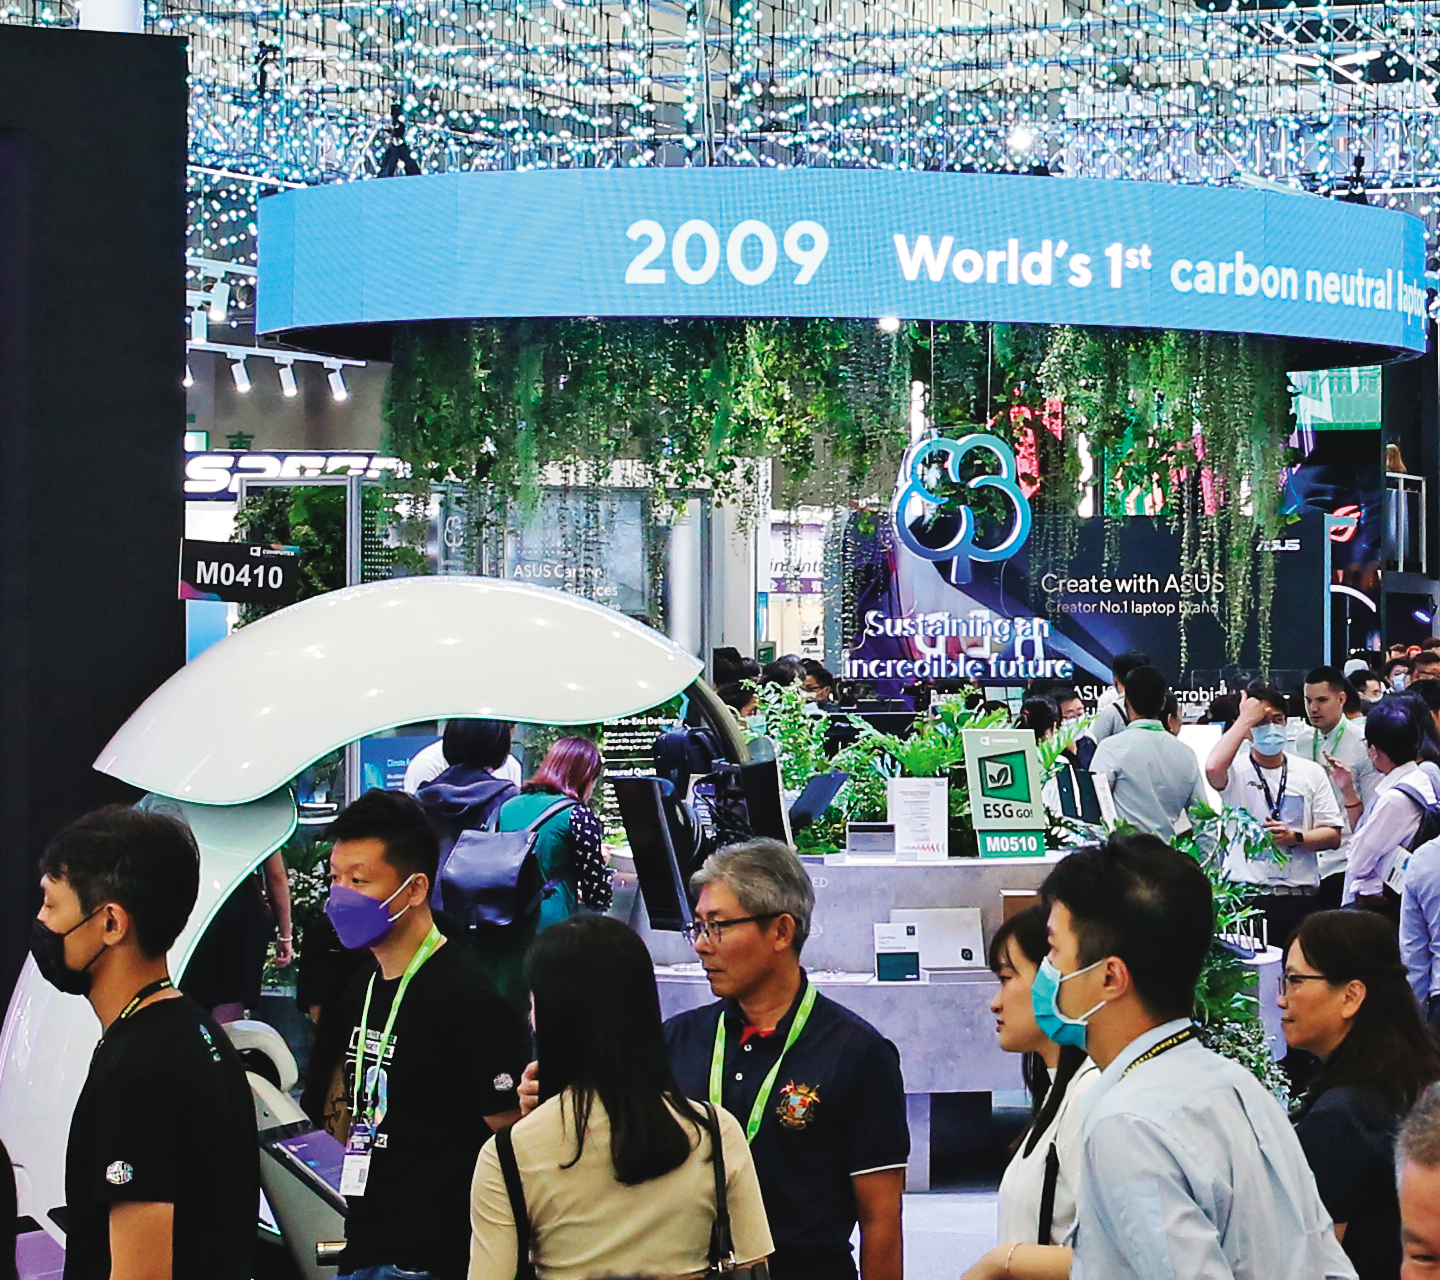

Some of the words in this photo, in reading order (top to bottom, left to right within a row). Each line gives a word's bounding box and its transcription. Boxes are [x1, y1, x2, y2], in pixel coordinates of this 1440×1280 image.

[624, 219, 829, 286] 2009
[1104, 241, 1153, 289] 1st
[1170, 250, 1299, 301] carbon
[1304, 267, 1393, 311] neutral
[196, 560, 284, 590] M0410
[1041, 573, 1112, 594] Create
[1115, 573, 1159, 594] with
[1045, 600, 1097, 614] Creator
[1099, 600, 1128, 614] No.1
[1131, 600, 1176, 616] laptop
[866, 609, 1010, 643] Sustaining
[1016, 616, 1051, 638] an
[844, 653, 985, 679] incredible
[988, 653, 1074, 679] future
[634, 767, 657, 777] Qualit
[983, 803, 1014, 819] ESG
[1016, 808, 1034, 819] GO!
[985, 836, 1038, 852] M0510
